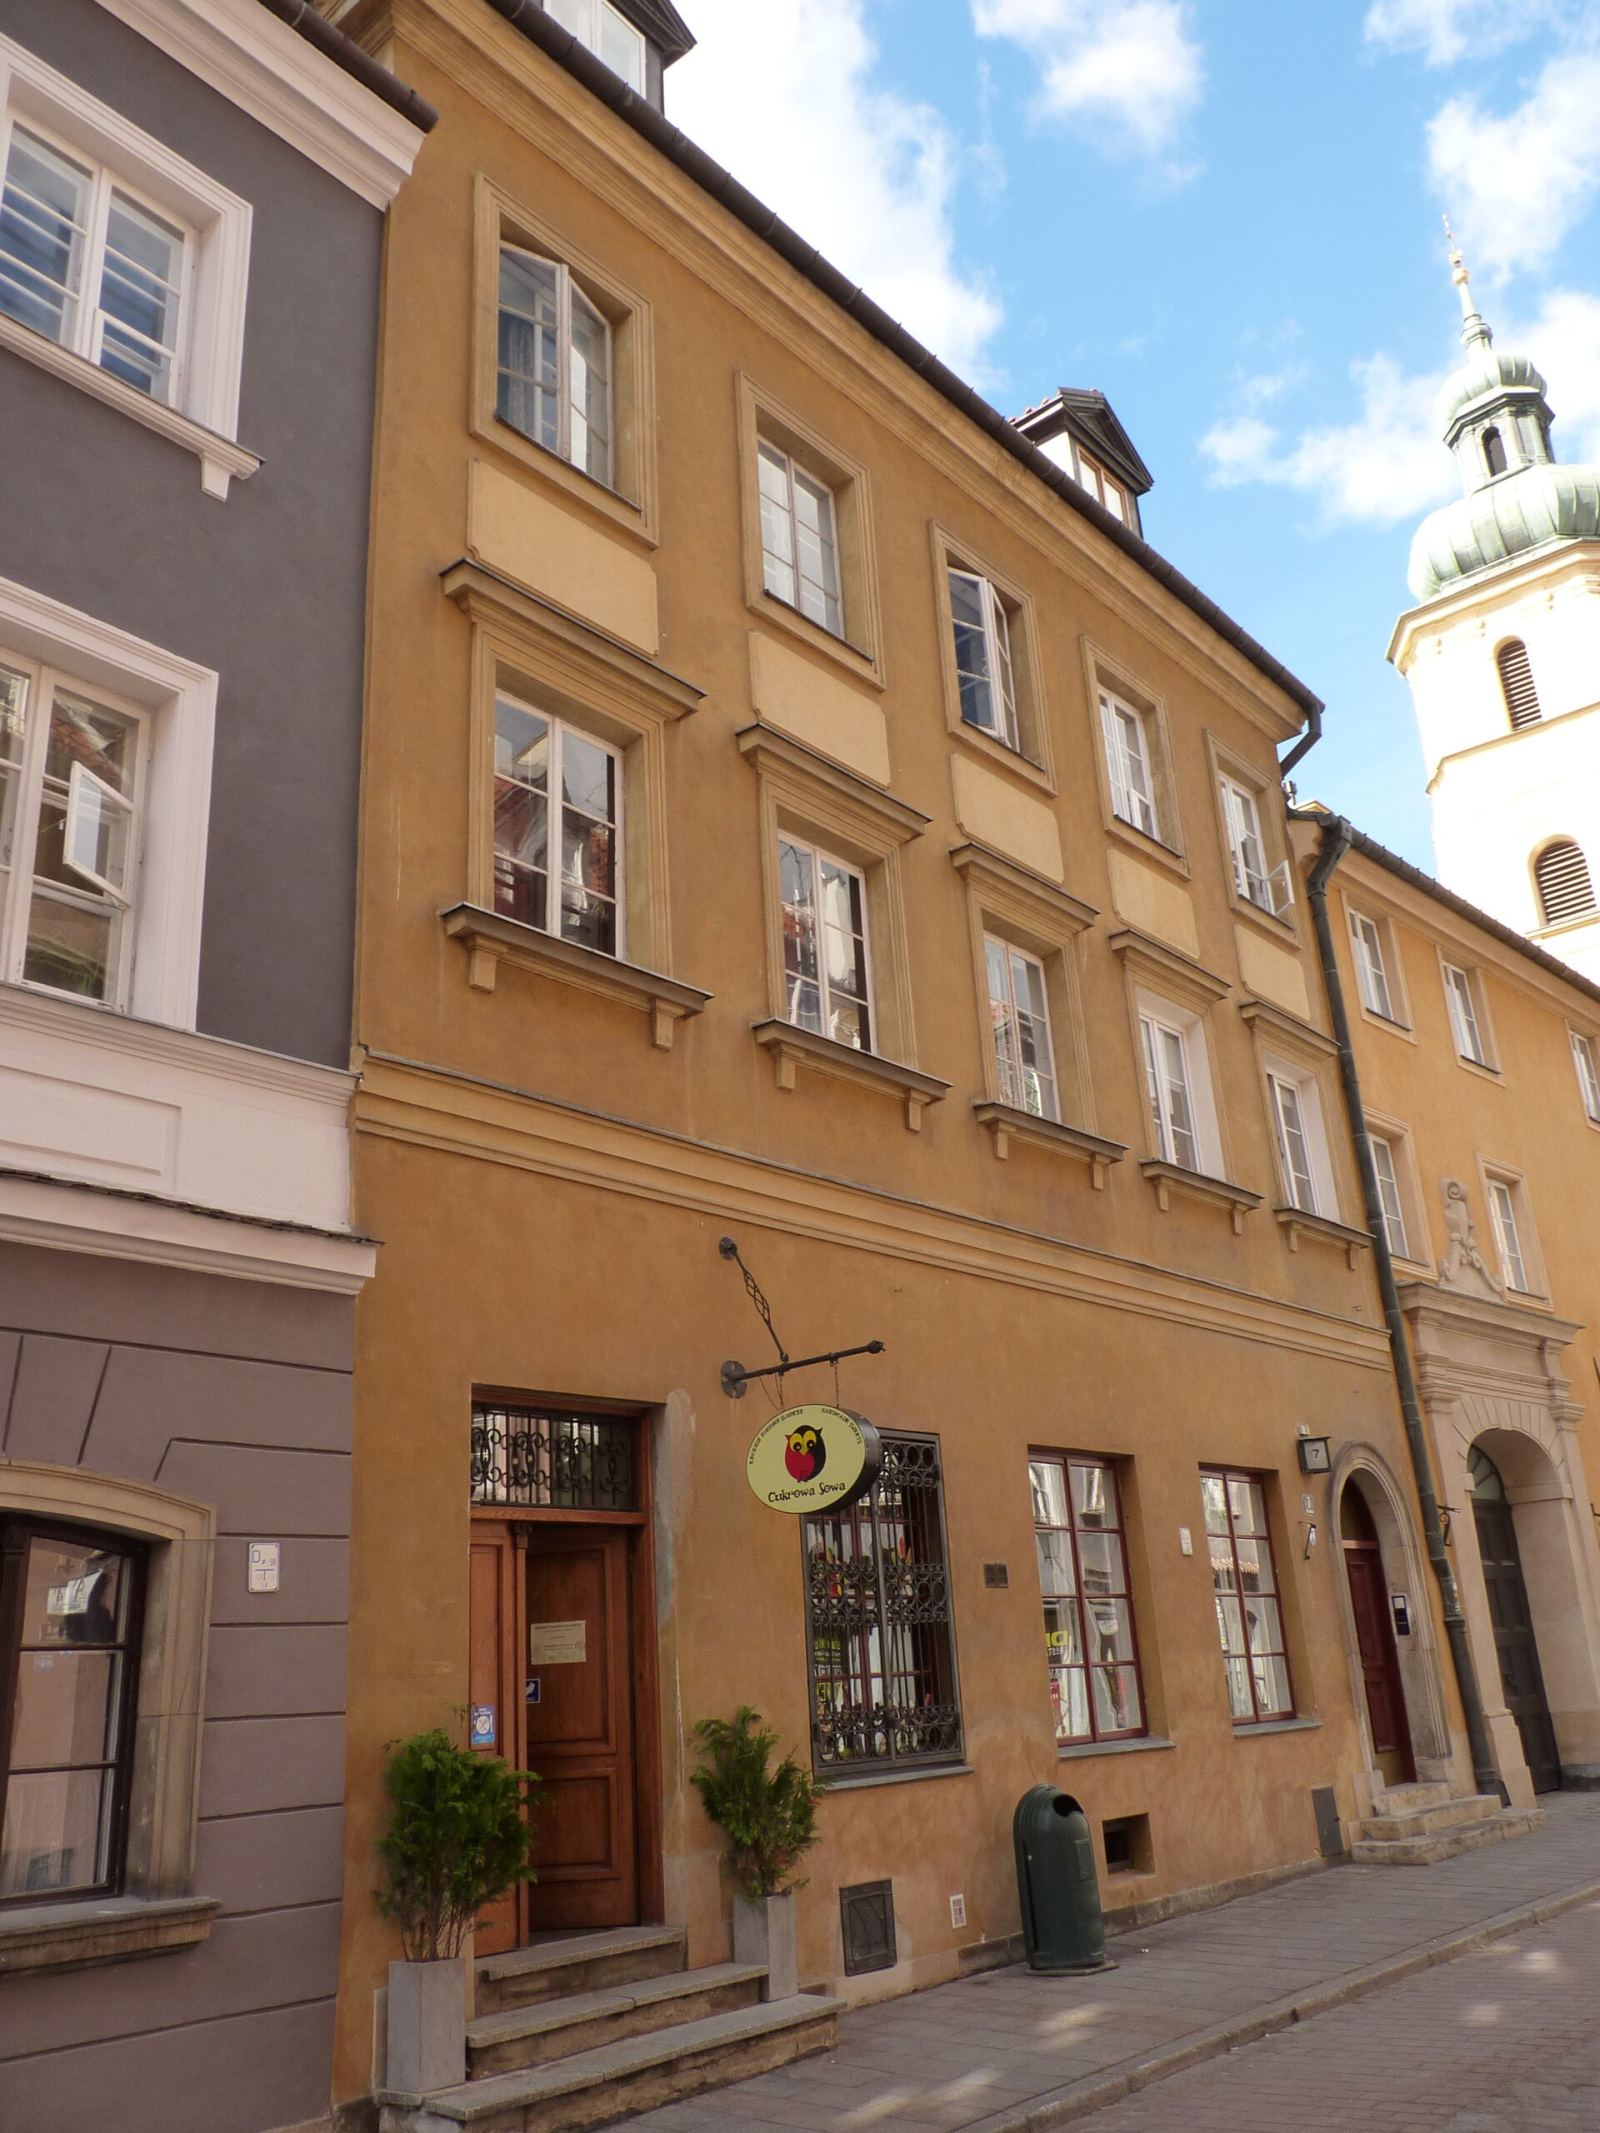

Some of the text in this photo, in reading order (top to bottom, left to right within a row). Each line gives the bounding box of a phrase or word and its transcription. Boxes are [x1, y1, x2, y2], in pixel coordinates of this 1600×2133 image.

[1312, 1449, 1320, 1459] 7
[768, 1482, 846, 1503] Cukrowa Sowa
